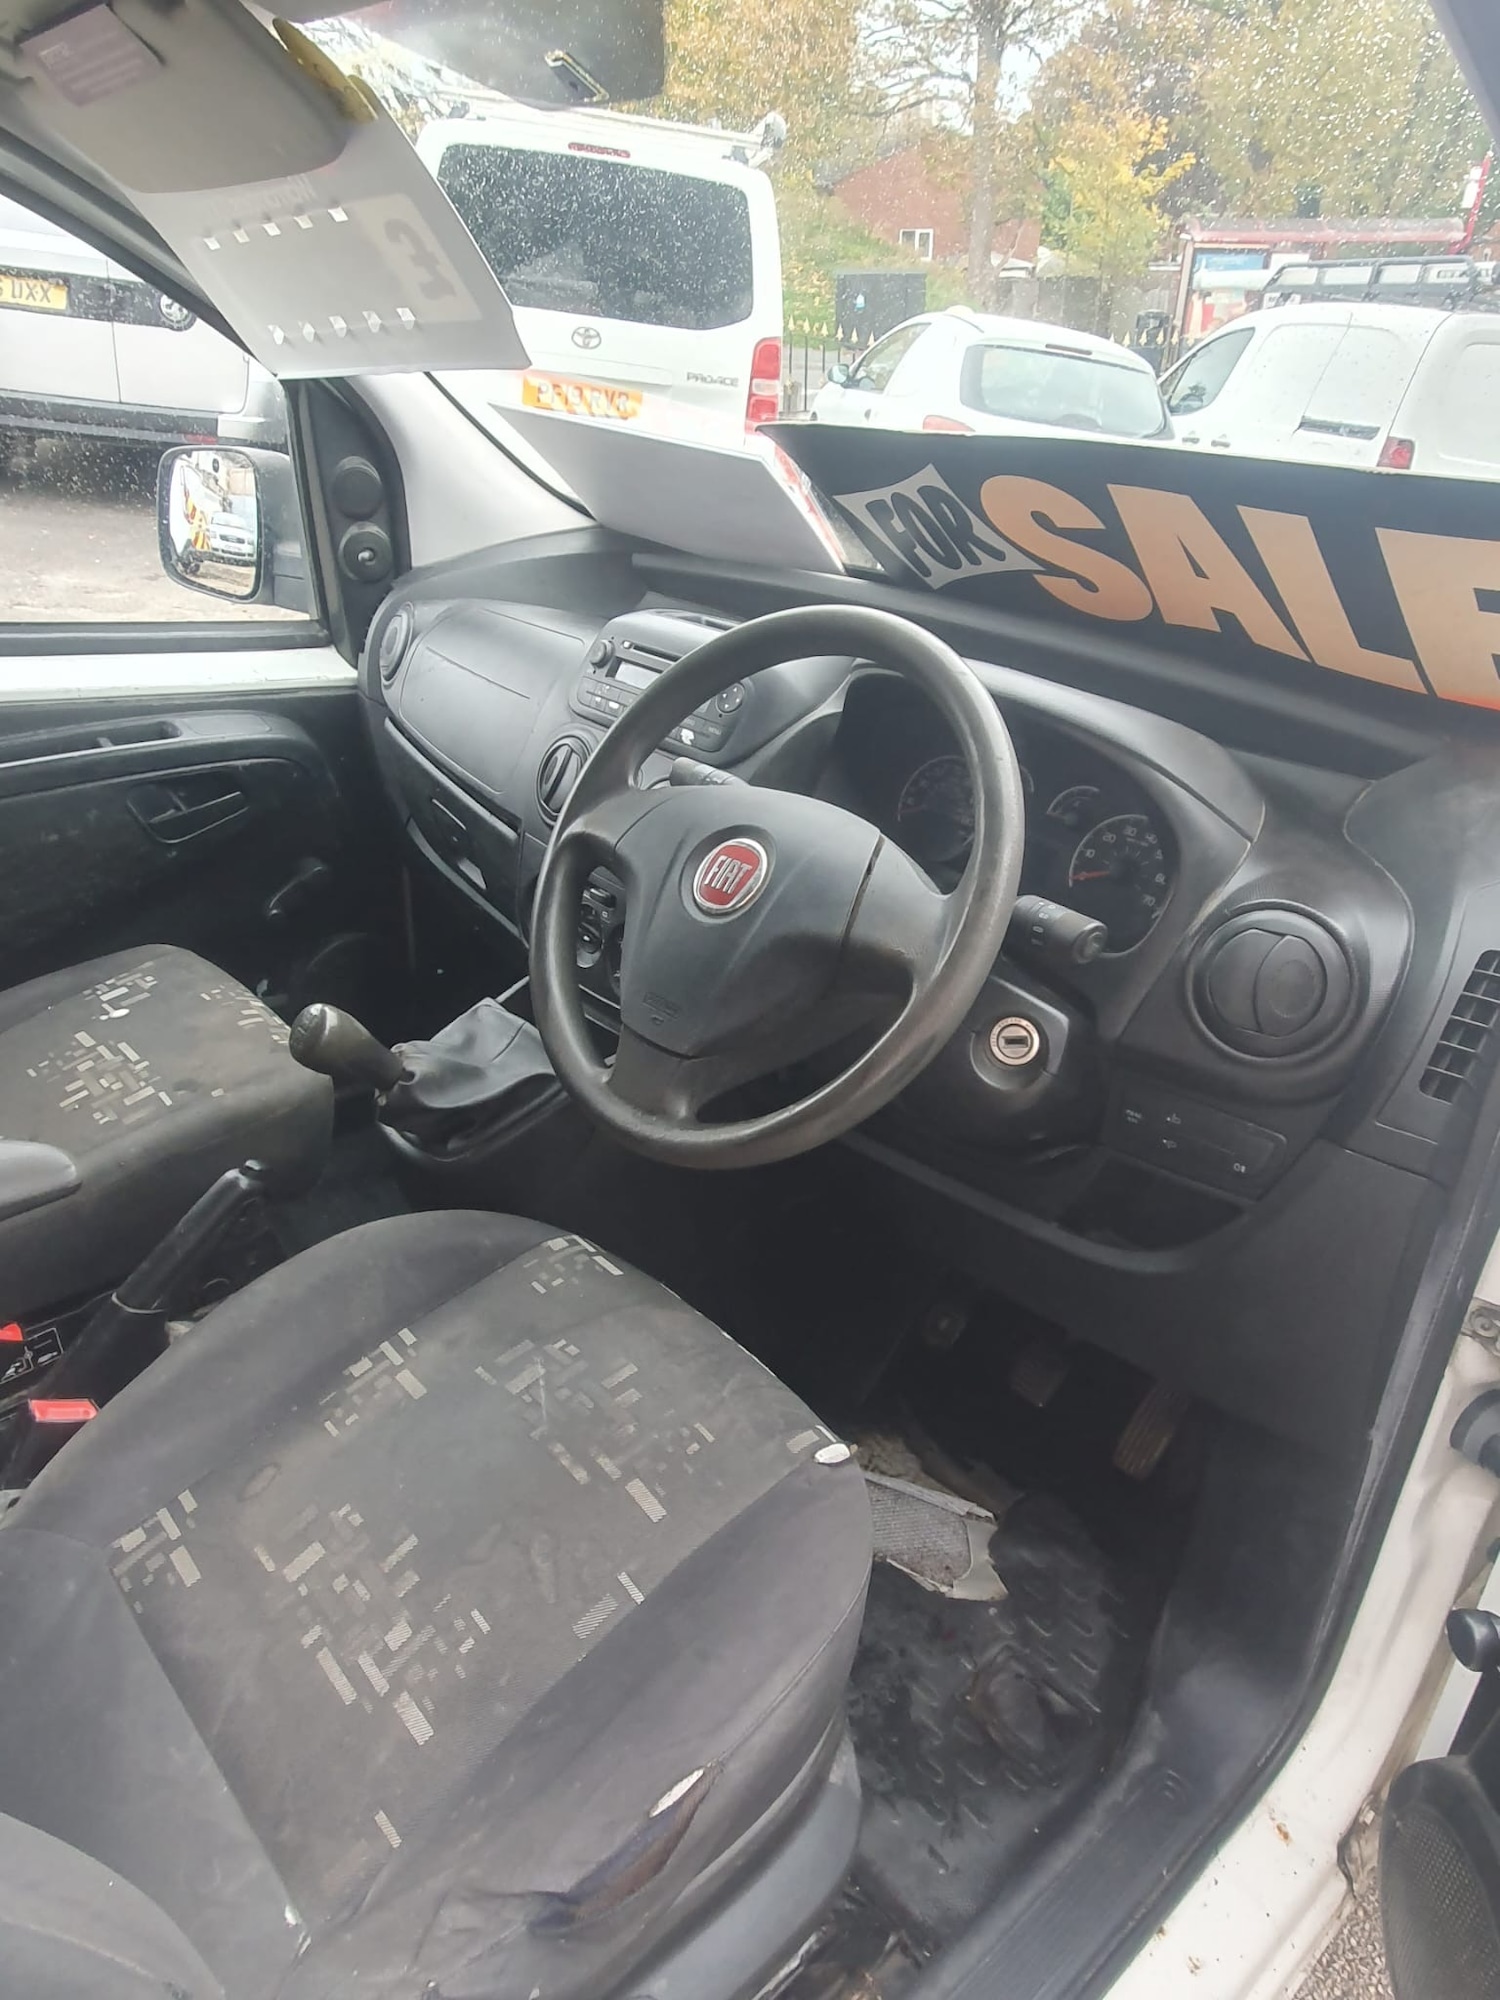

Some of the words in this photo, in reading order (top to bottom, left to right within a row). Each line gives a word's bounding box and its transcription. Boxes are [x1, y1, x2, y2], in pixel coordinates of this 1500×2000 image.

[686, 371, 739, 389] PROACE
[865, 485, 1006, 578] FOR
[704, 854, 753, 894] FIAT
